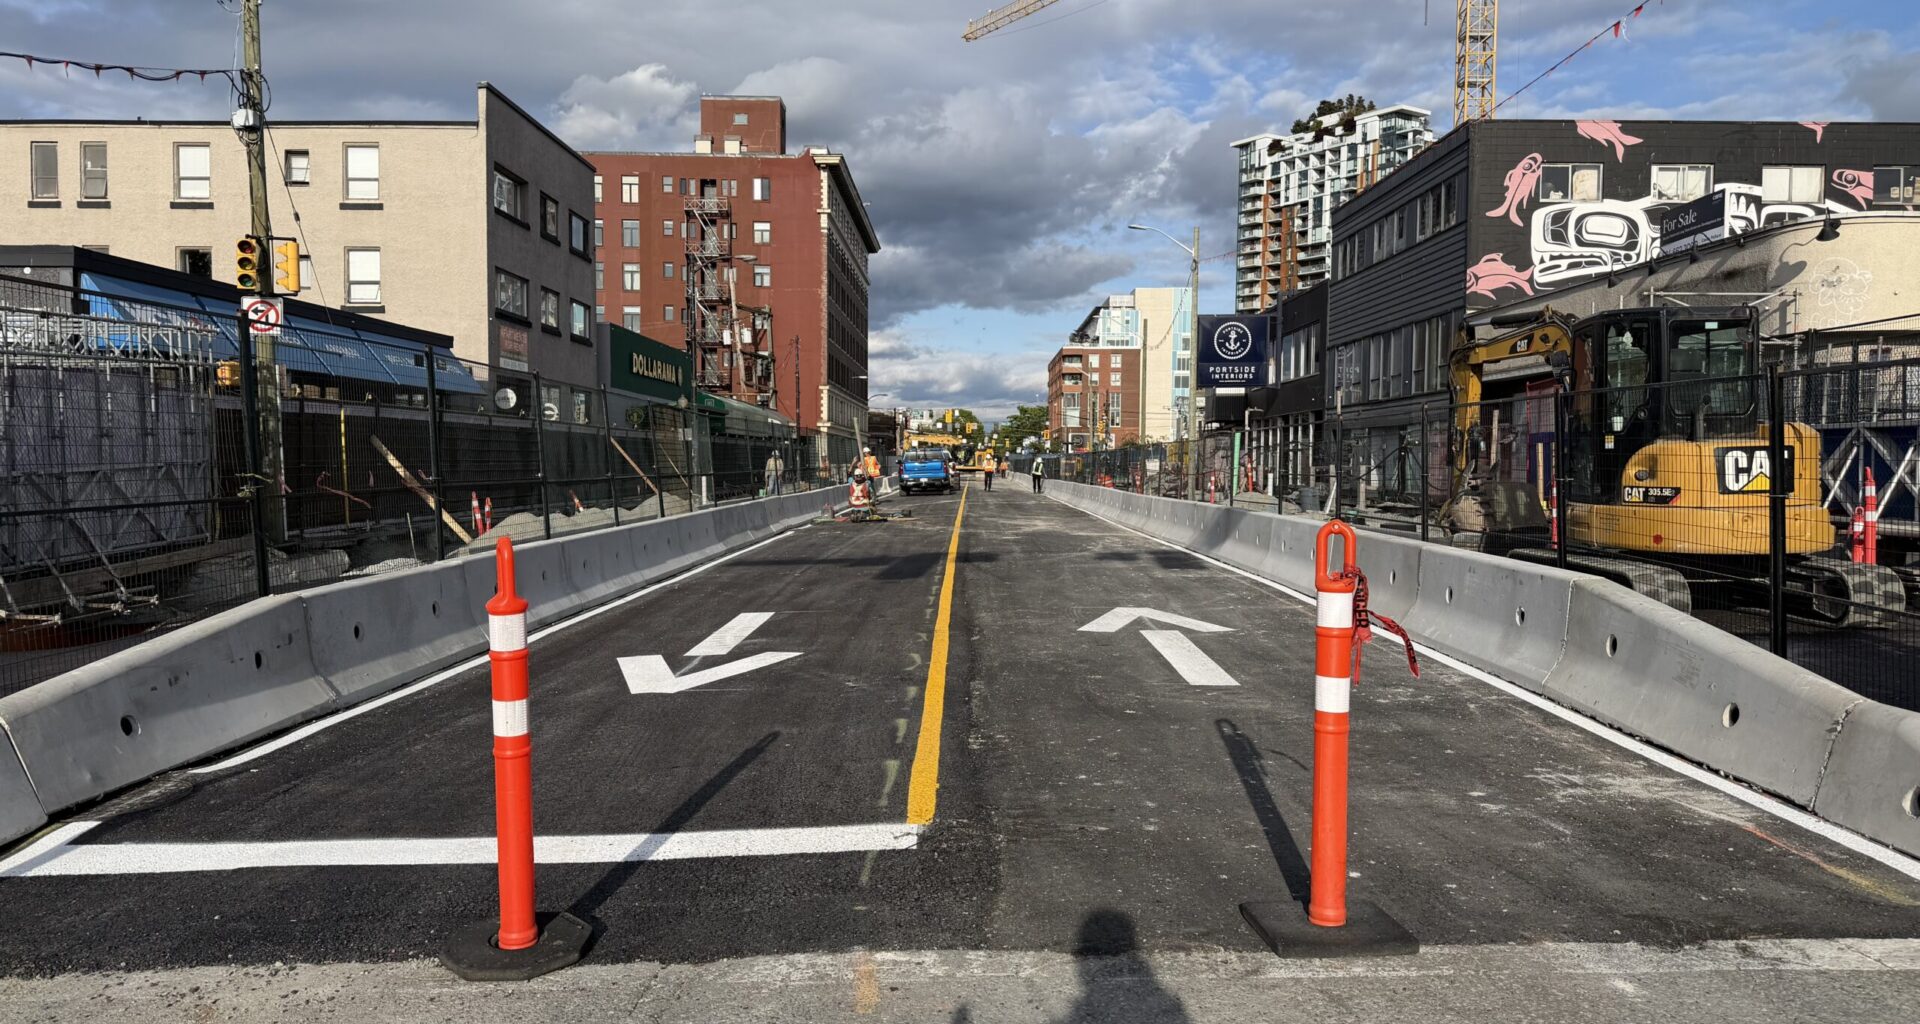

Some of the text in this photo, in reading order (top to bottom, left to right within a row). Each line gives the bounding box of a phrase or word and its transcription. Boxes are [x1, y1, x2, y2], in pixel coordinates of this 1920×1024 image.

[1663, 219, 1676, 234] For
[1678, 209, 1697, 227] Sale
[1516, 339, 1528, 352] CAT
[632, 352, 676, 384] DOLLARAMA
[1724, 450, 1788, 492] CA
[1624, 487, 1645, 502] CAT
